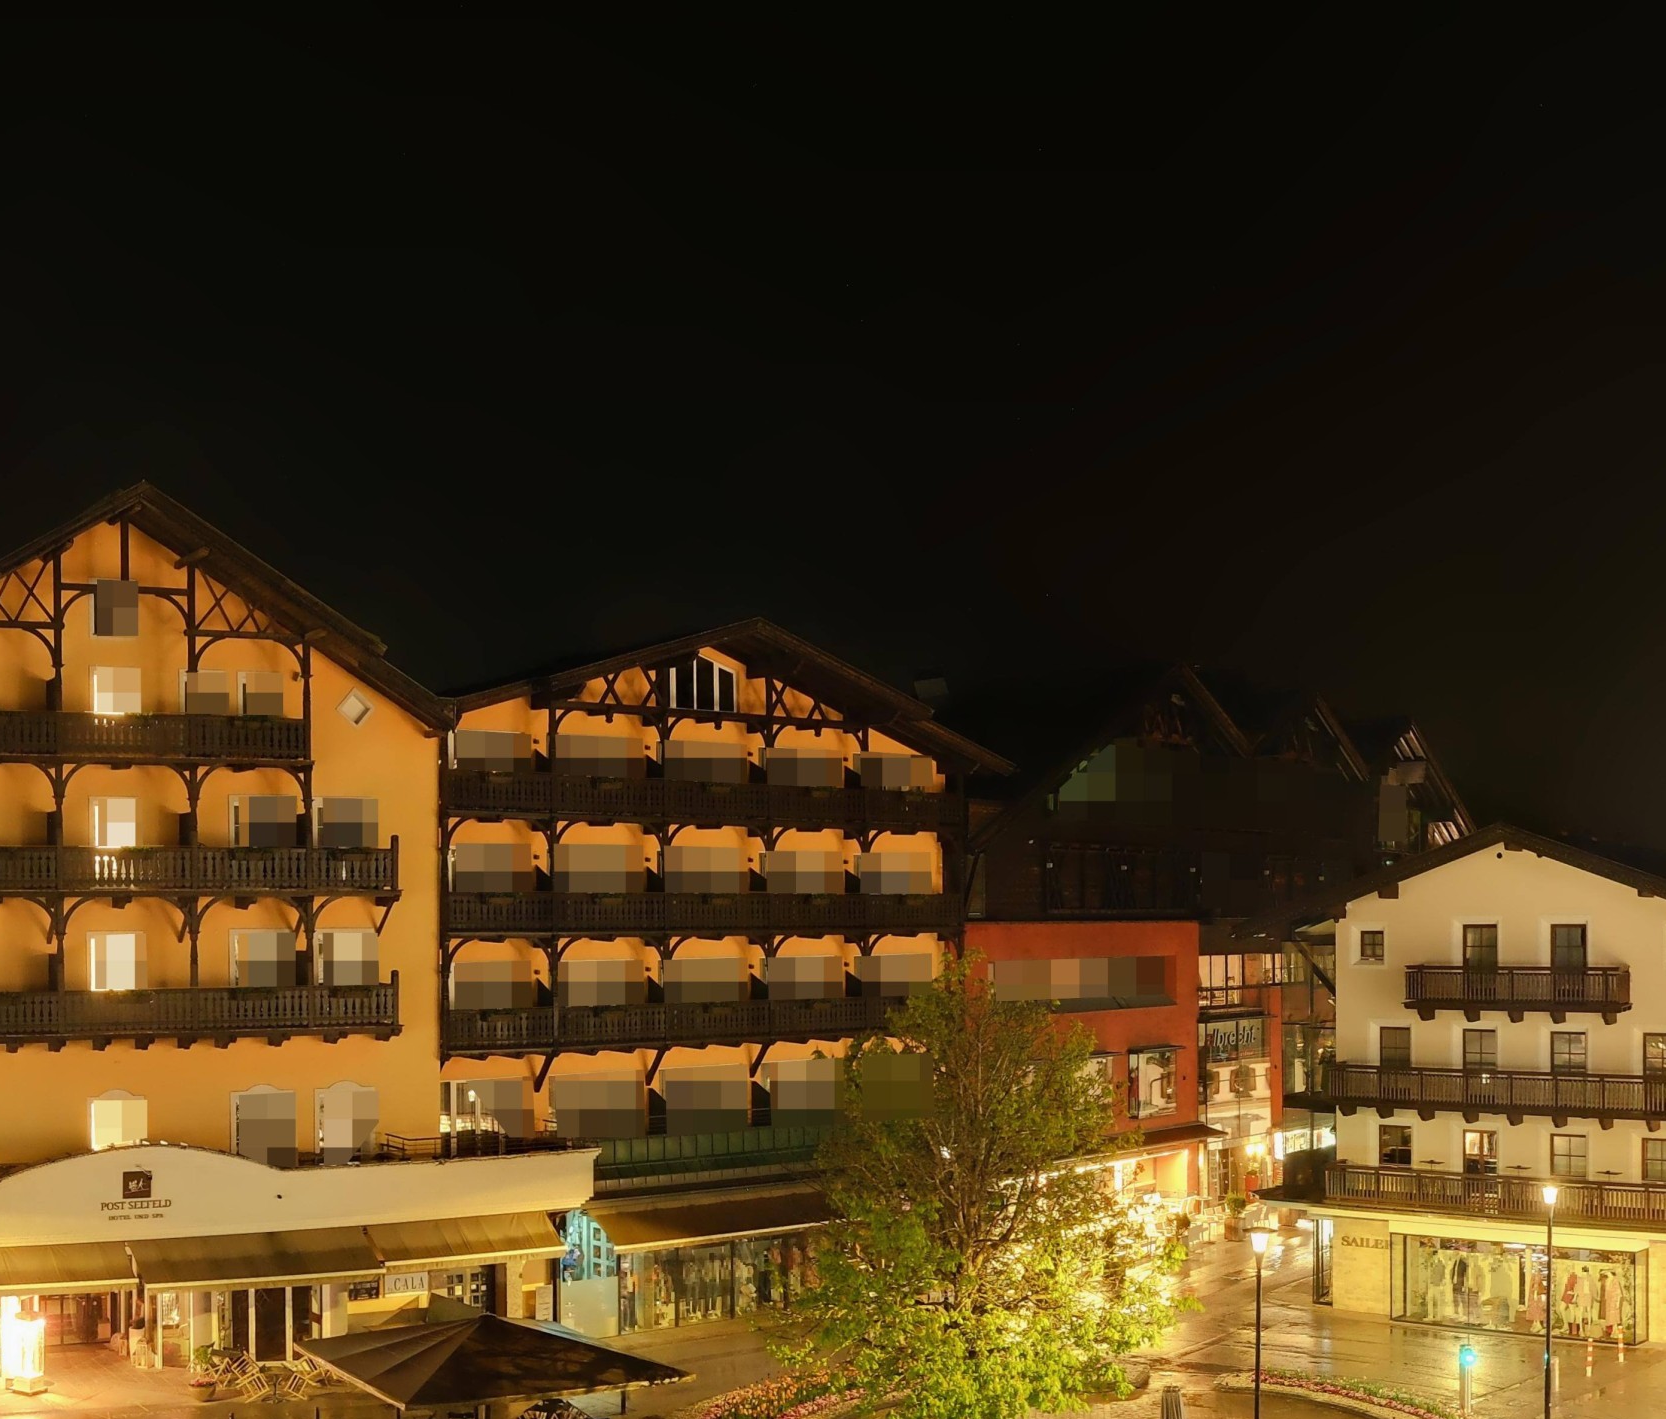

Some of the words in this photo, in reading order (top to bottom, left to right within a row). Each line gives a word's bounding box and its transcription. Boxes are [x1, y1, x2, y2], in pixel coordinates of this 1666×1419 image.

[1206, 1025, 1255, 1048] lbrecht
[101, 1201, 126, 1212] POST
[128, 1199, 172, 1210] SEEFELD
[393, 1276, 425, 1292] CALA
